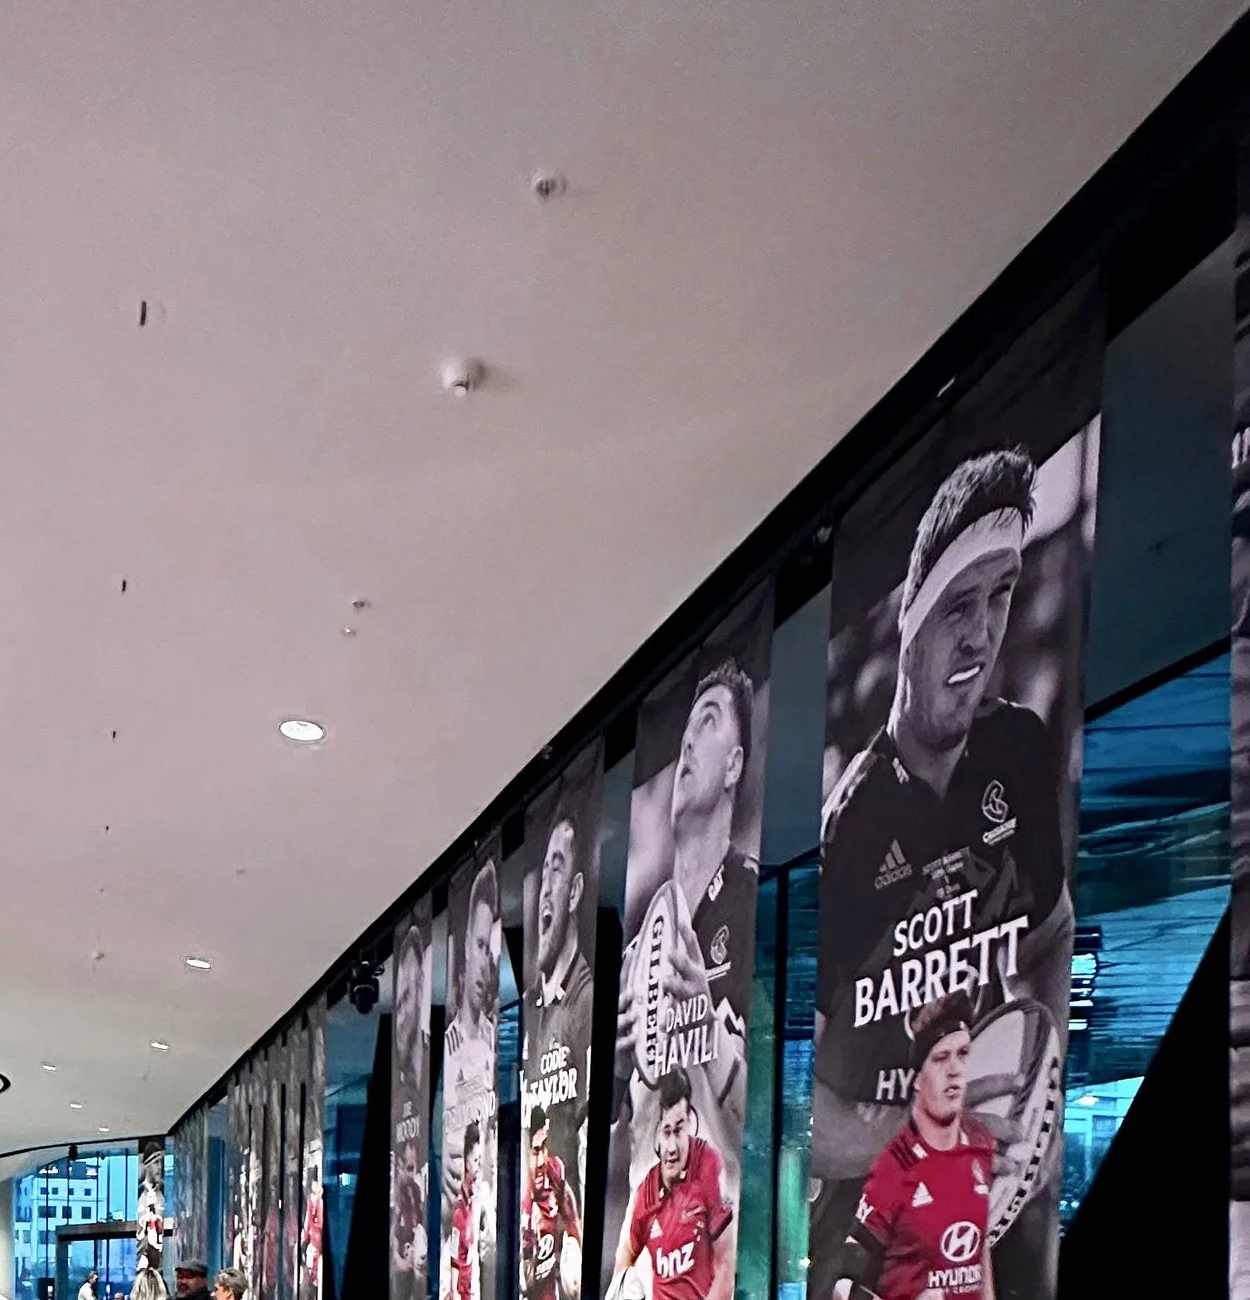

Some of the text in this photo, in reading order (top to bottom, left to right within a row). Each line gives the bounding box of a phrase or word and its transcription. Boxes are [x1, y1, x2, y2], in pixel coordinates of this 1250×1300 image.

[893, 888, 978, 957] SCOTT
[853, 914, 1030, 1028] BARRETT
[665, 993, 709, 1033] DAVID
[540, 1045, 571, 1075] CODIE
[654, 1020, 721, 1078] HAVILI
[530, 1067, 578, 1114] TAYLOR
[656, 1241, 695, 1279] bnz
